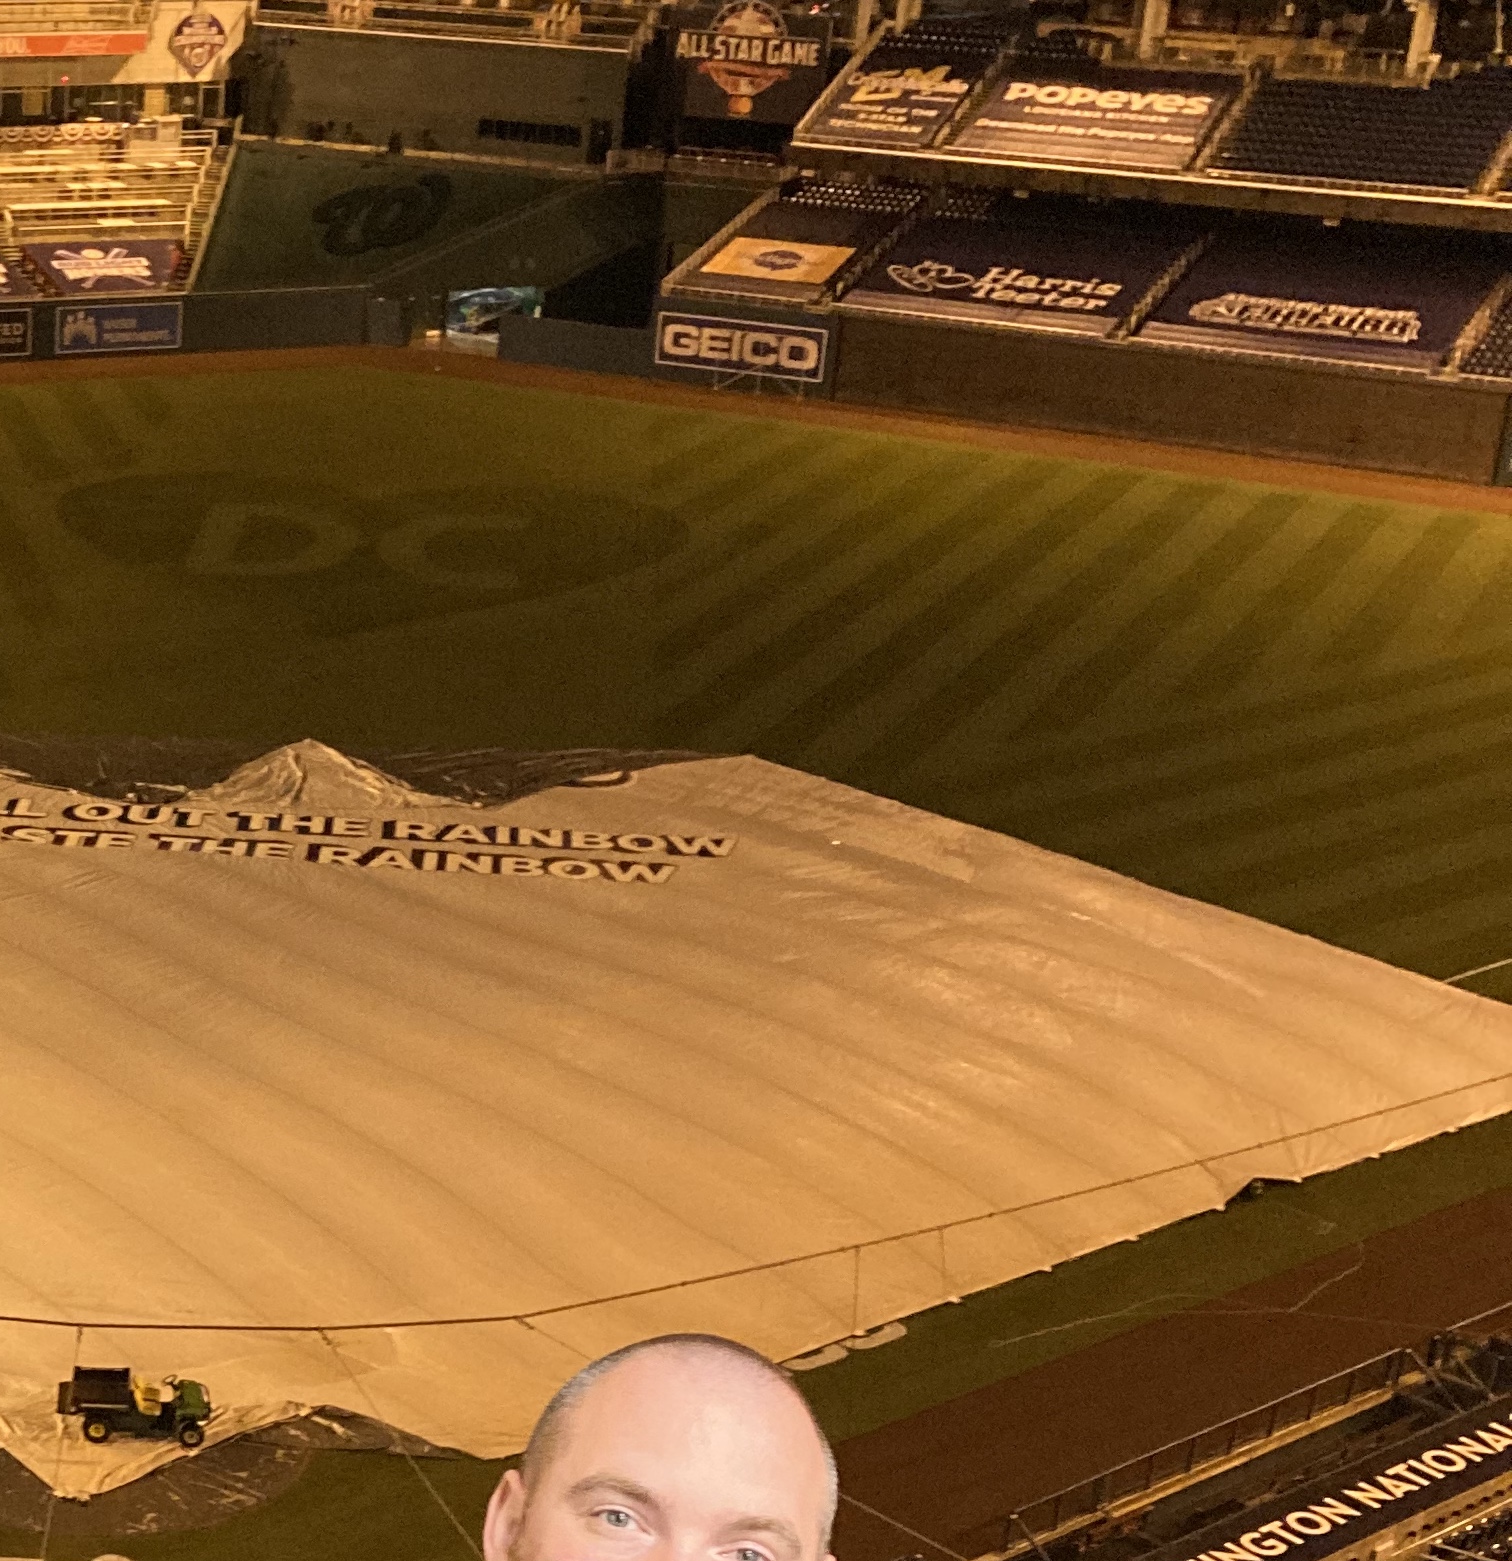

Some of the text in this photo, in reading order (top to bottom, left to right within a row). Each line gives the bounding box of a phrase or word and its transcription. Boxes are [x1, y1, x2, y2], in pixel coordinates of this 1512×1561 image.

[766, 39, 821, 66] GAME
[972, 285, 1107, 310] Teeter
[984, 267, 1122, 296] Harris
[662, 323, 820, 372] GEICO
[63, 801, 219, 828] OUT
[227, 811, 372, 837] THE
[382, 819, 739, 857] RAINBOW
[148, 833, 294, 859] THE
[305, 842, 681, 884] RAINBOW
